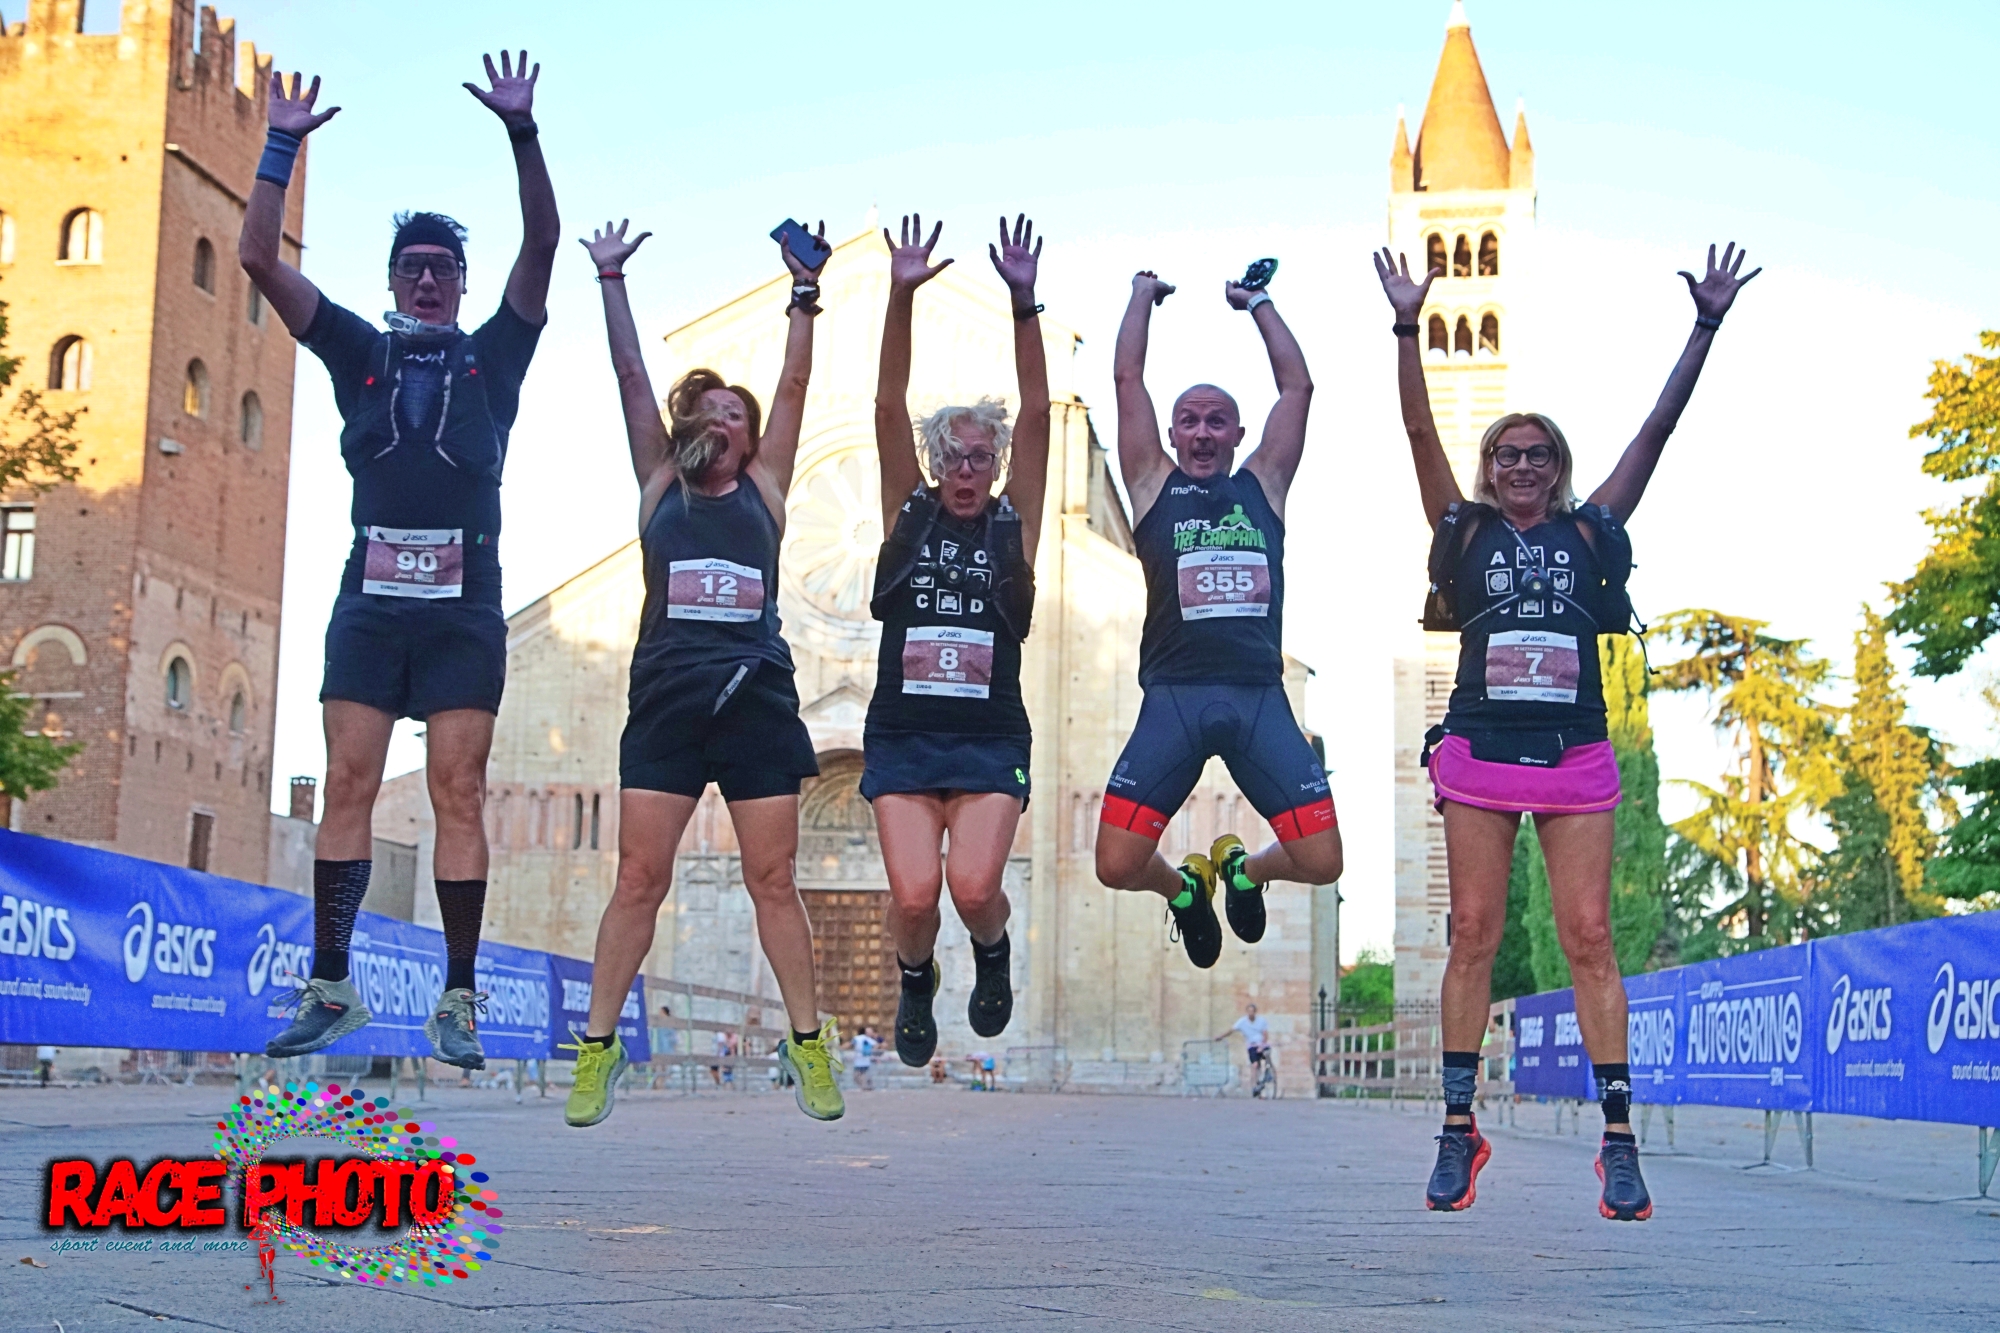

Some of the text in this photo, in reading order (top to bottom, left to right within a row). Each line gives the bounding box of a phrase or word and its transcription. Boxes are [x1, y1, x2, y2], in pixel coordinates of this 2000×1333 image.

[396, 551, 438, 572] 90
[974, 550, 988, 564] O
[1490, 550, 1570, 566] A O
[700, 575, 738, 595] 12
[1196, 571, 1254, 592] 355
[916, 594, 984, 613] C D
[1552, 600, 1564, 614] D
[938, 648, 958, 670] 8
[1526, 652, 1544, 674] 7
[0, 895, 76, 961] asics
[154, 922, 217, 978] asics
[1848, 987, 1892, 1042] asics
[1954, 979, 2000, 1040] asic
[1628, 1008, 1674, 1066] TORINO
[1686, 991, 1802, 1065] AUTOTORINO
